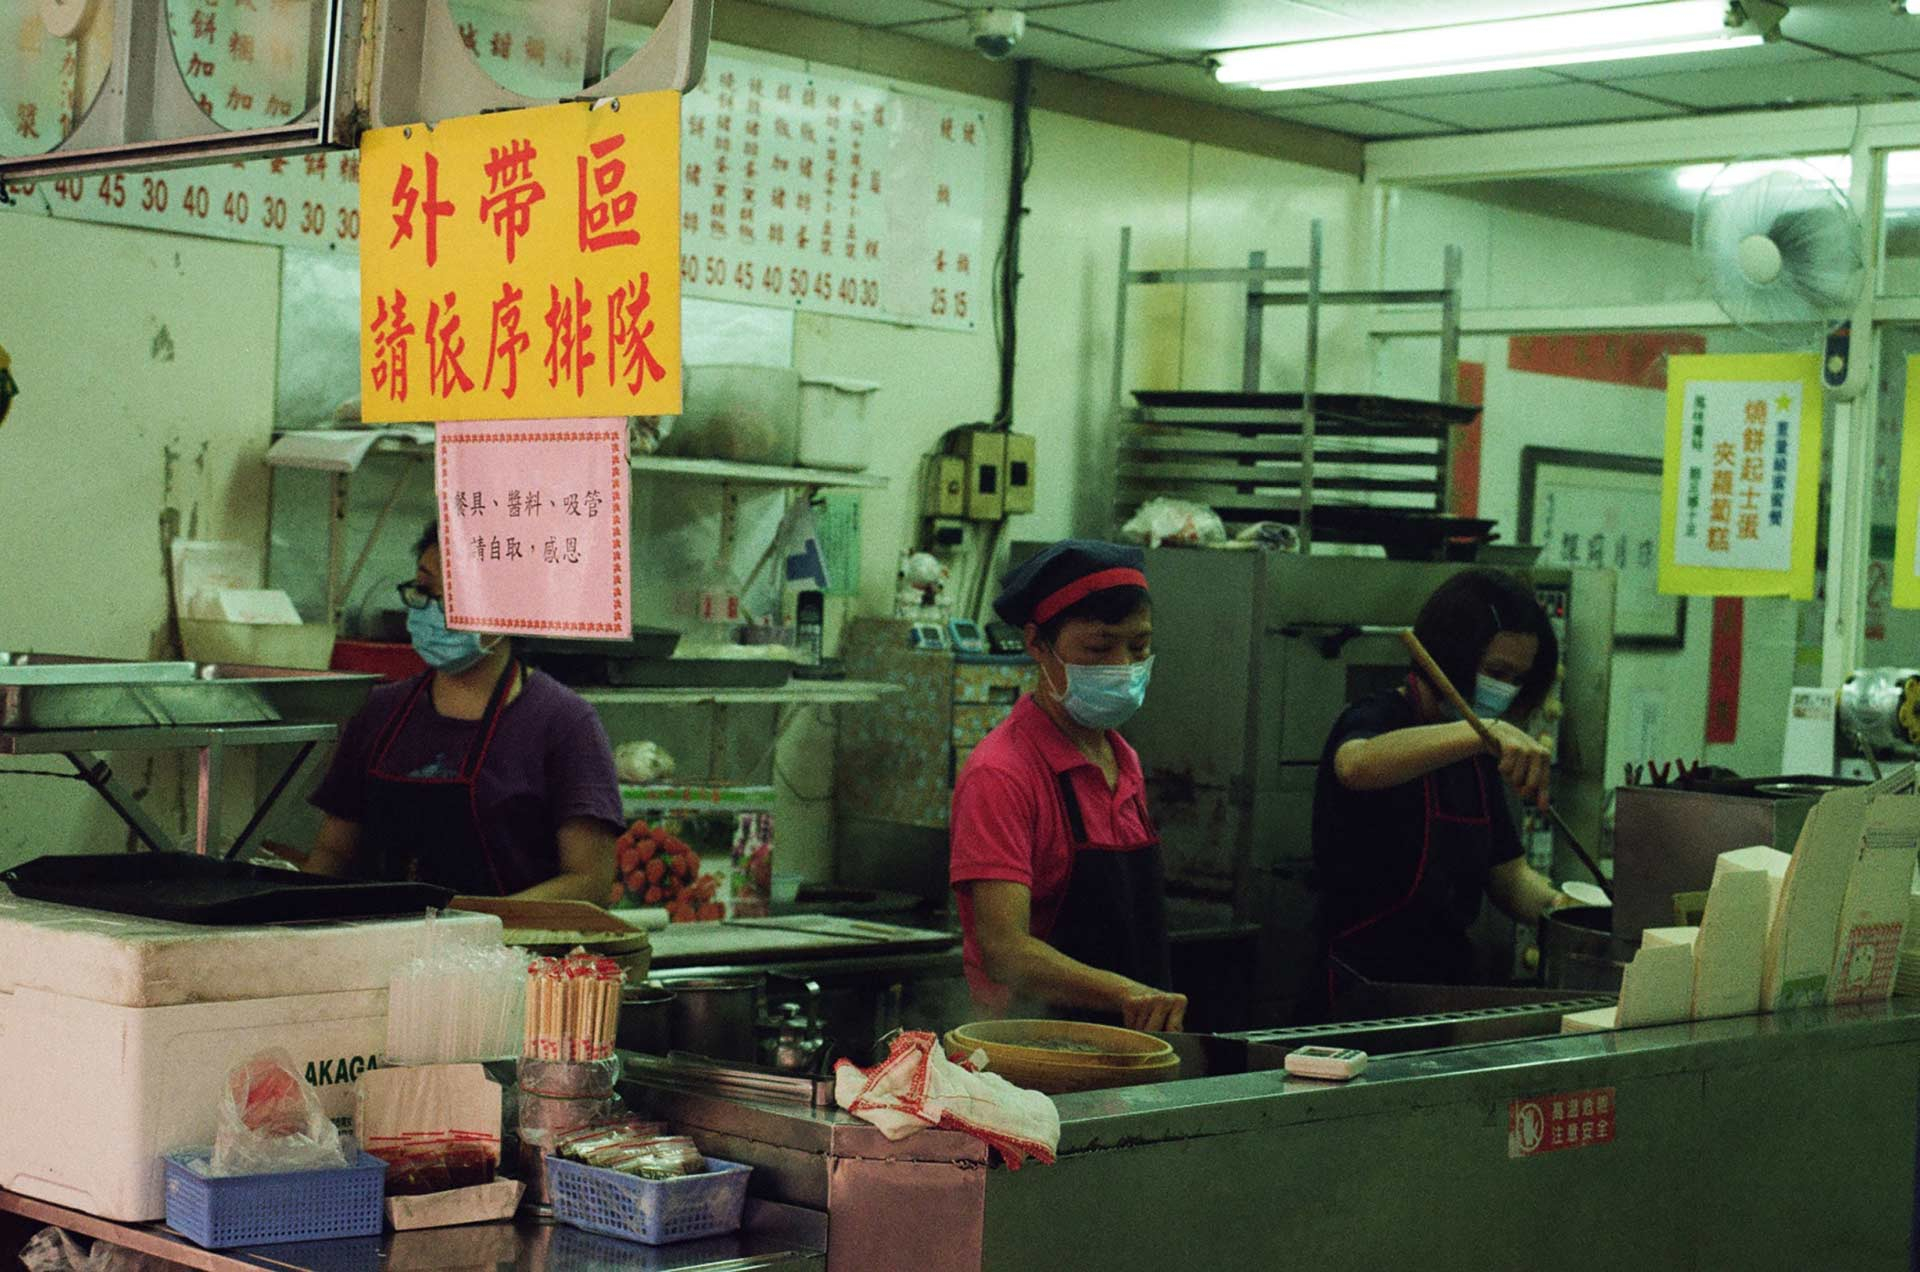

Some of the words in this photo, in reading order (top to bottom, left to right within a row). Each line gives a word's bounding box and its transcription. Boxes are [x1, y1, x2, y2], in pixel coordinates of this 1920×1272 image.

[55, 175, 84, 202] 40
[99, 174, 126, 208] 45
[142, 178, 168, 213] 30
[183, 184, 210, 219] 40
[224, 190, 249, 224] 40
[263, 196, 287, 231] 30
[301, 201, 325, 236] 30
[337, 207, 359, 240] 30
[390, 134, 641, 268] 外帶區
[680, 254, 699, 285] 40
[705, 256, 726, 287] 50
[733, 261, 754, 290] 45
[762, 265, 782, 295] 40
[790, 267, 810, 298] 50
[813, 271, 833, 301] 45
[838, 276, 857, 305] 40
[860, 277, 880, 308] 30
[931, 286, 947, 316] 25
[954, 290, 969, 319] 15
[370, 272, 667, 404] 請依序排隊
[454, 489, 603, 518] 餐具、醬料、吸管
[1551, 1119, 1609, 1145] 注意安全
